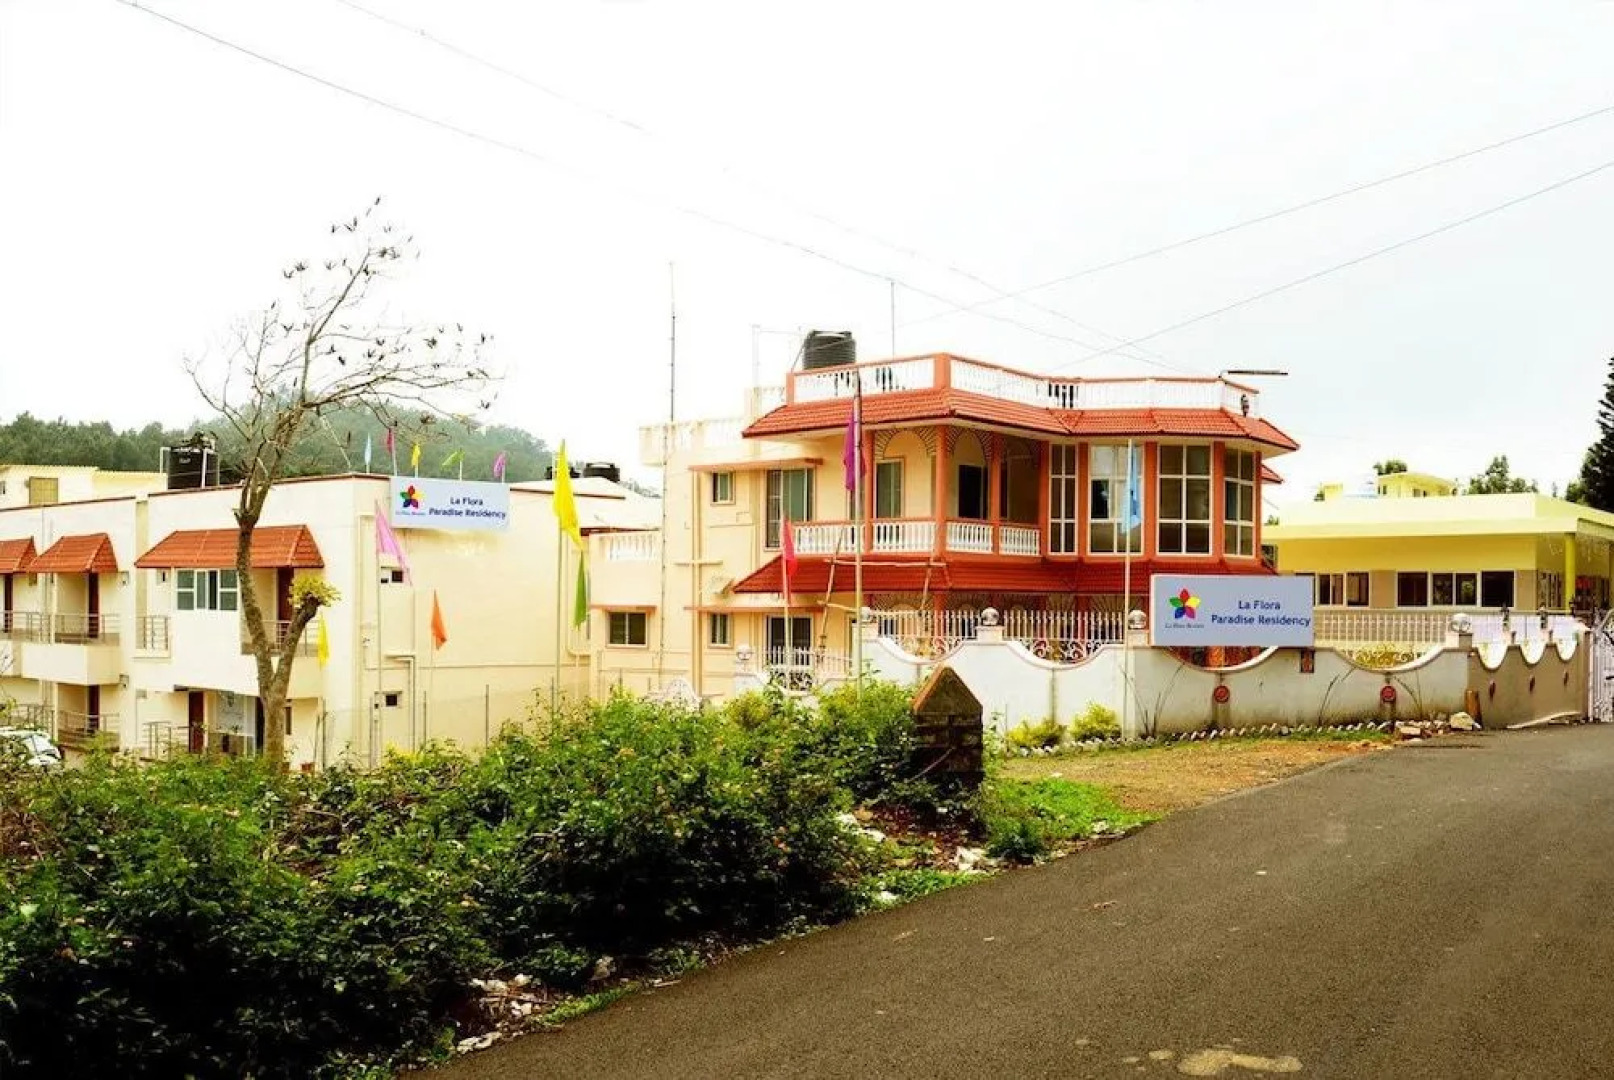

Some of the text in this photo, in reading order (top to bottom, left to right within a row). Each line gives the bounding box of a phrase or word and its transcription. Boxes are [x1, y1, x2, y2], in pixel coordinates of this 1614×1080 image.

[450, 497, 483, 506] La Flora
[429, 508, 463, 517] Paradise
[466, 509, 506, 520] Residency
[1238, 600, 1281, 610] La Flora
[1211, 614, 1311, 627] Paradise Residency
